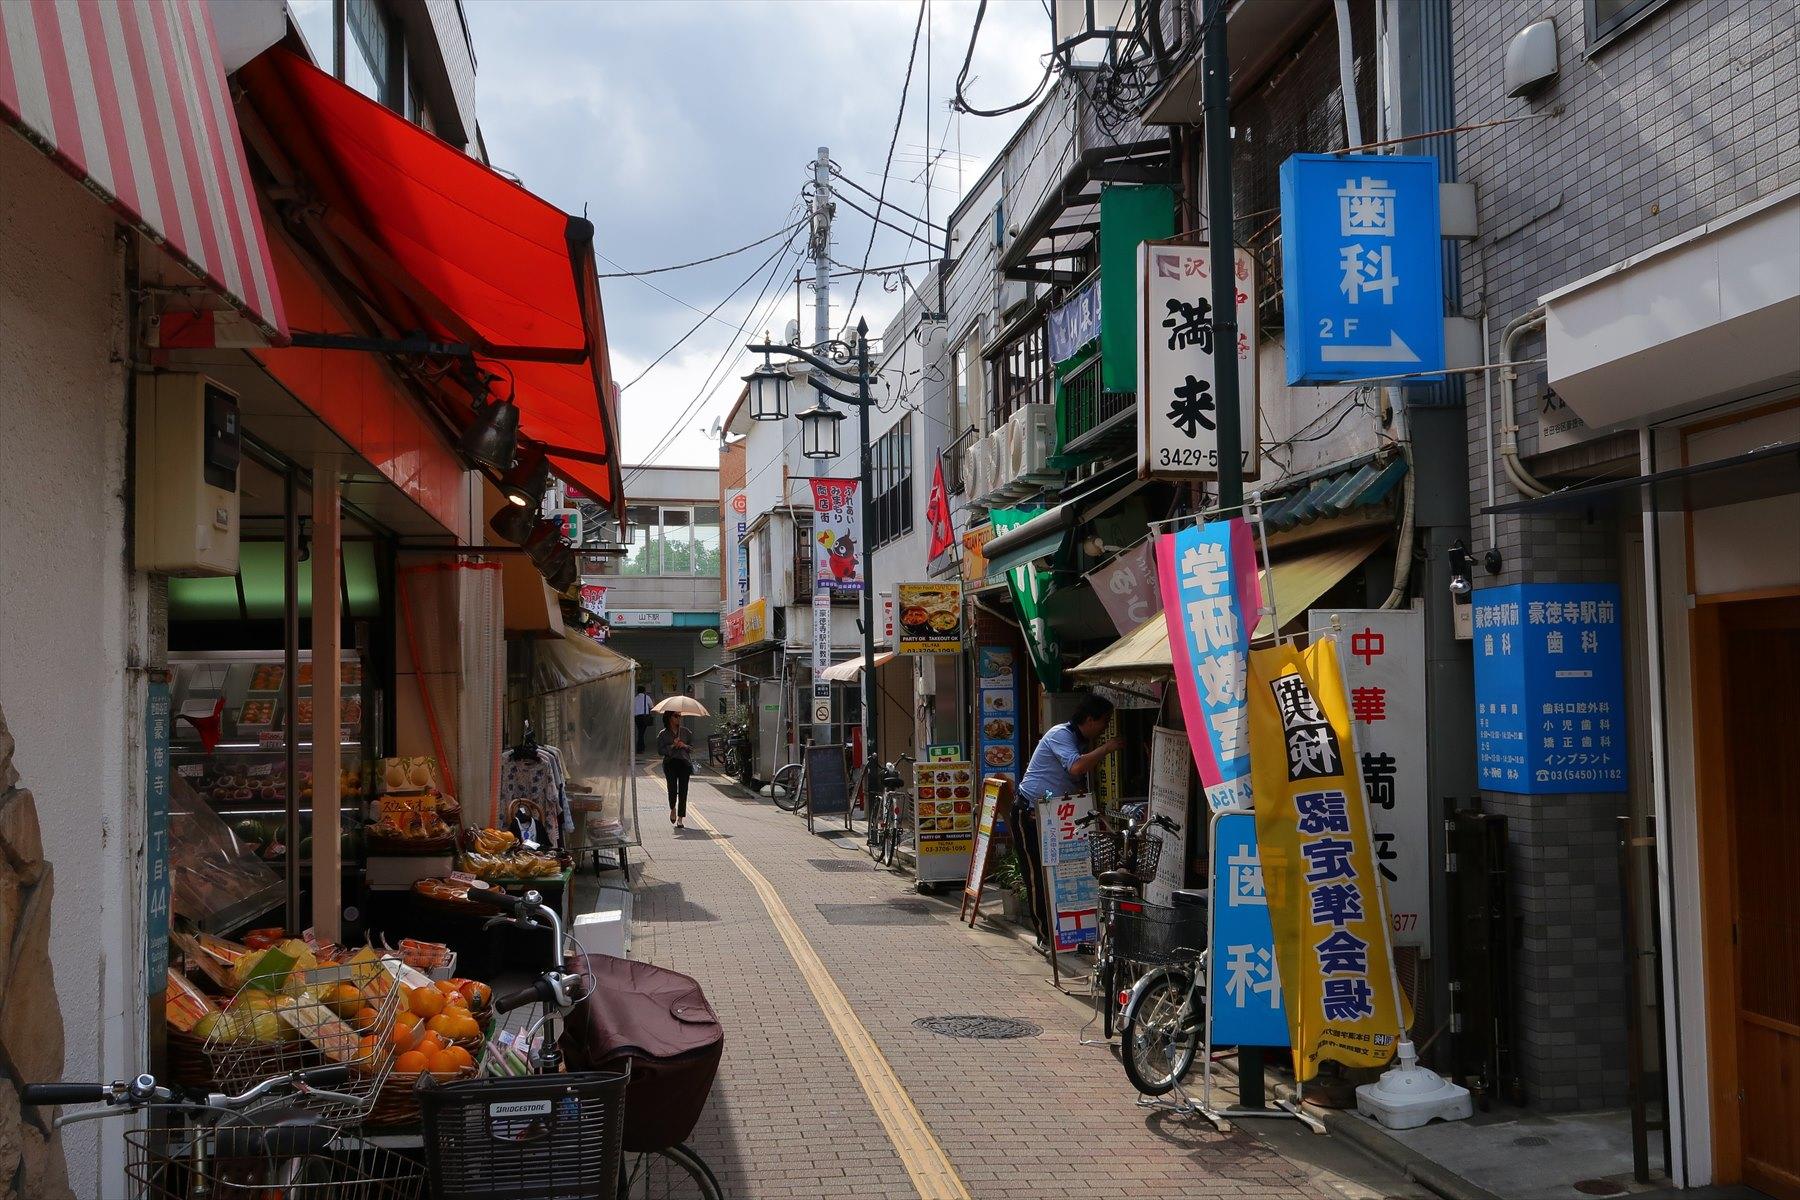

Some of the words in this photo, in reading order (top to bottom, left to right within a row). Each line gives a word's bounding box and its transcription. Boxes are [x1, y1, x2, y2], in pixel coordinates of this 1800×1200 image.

[1336, 175, 1400, 305] 歯科
[1161, 297, 1217, 439] 満来
[1159, 447, 1250, 467] 3429-57
[830, 486, 843, 523] みまもり
[845, 487, 855, 524] ふれあい
[1475, 603, 1520, 629] 豪徳寺駅前
[1528, 601, 1615, 625] 豪徳寺駅前
[1484, 632, 1512, 656] 歯科
[1546, 630, 1599, 654] 歯科
[1351, 627, 1386, 725] 中華
[1542, 702, 1610, 715] 歯科口腔外科
[1543, 719, 1610, 732] 小児歯科
[1543, 735, 1611, 749] 矯正歯科
[1544, 753, 1611, 766] インプラント
[1550, 769, 1622, 781] 03(5450)1182
[495, 1103, 545, 1114] BRIDGESTONE
